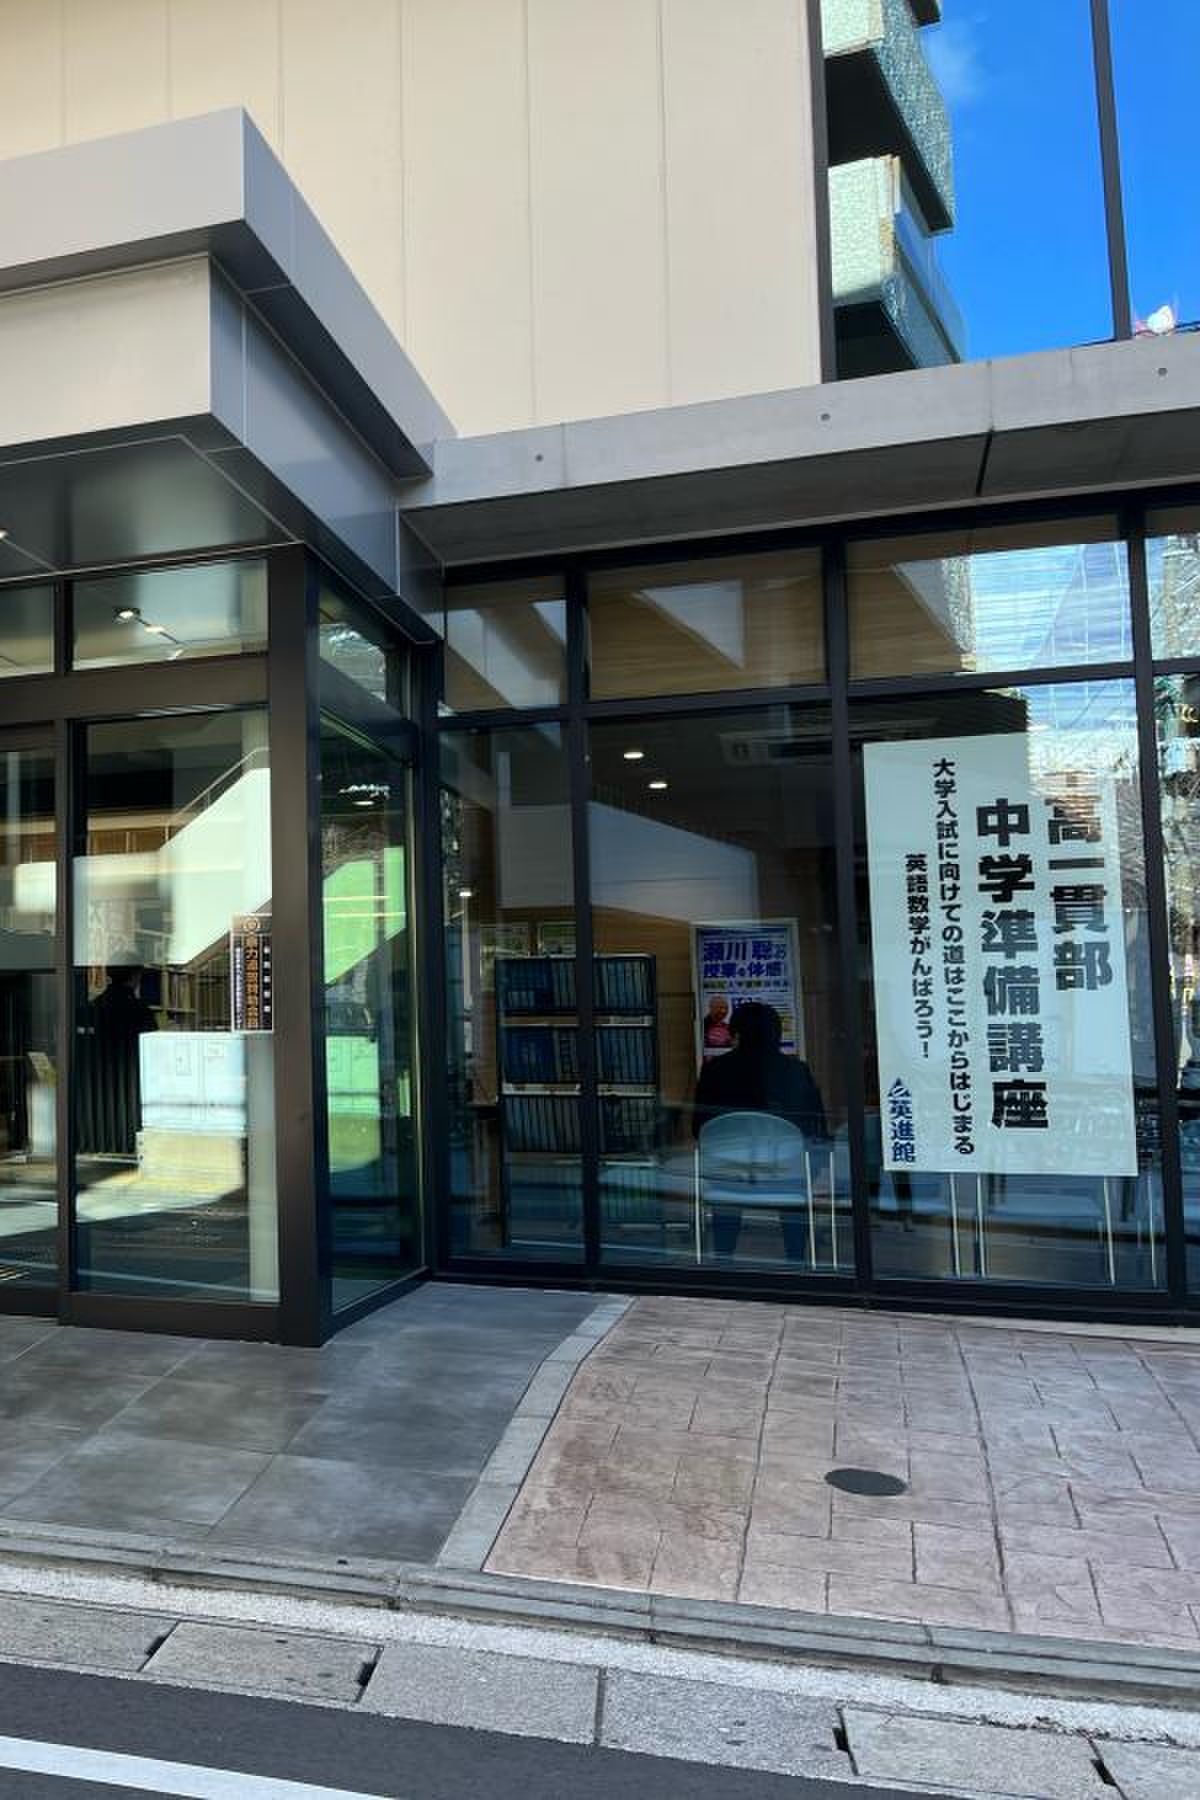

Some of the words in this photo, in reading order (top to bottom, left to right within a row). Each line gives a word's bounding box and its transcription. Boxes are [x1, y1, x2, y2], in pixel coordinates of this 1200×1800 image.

[933, 757, 975, 1156] 大学入試に向けての道はここからはじまる
[976, 798, 1049, 1130] 中学準備講座
[889, 1099, 916, 1163] 英進館
